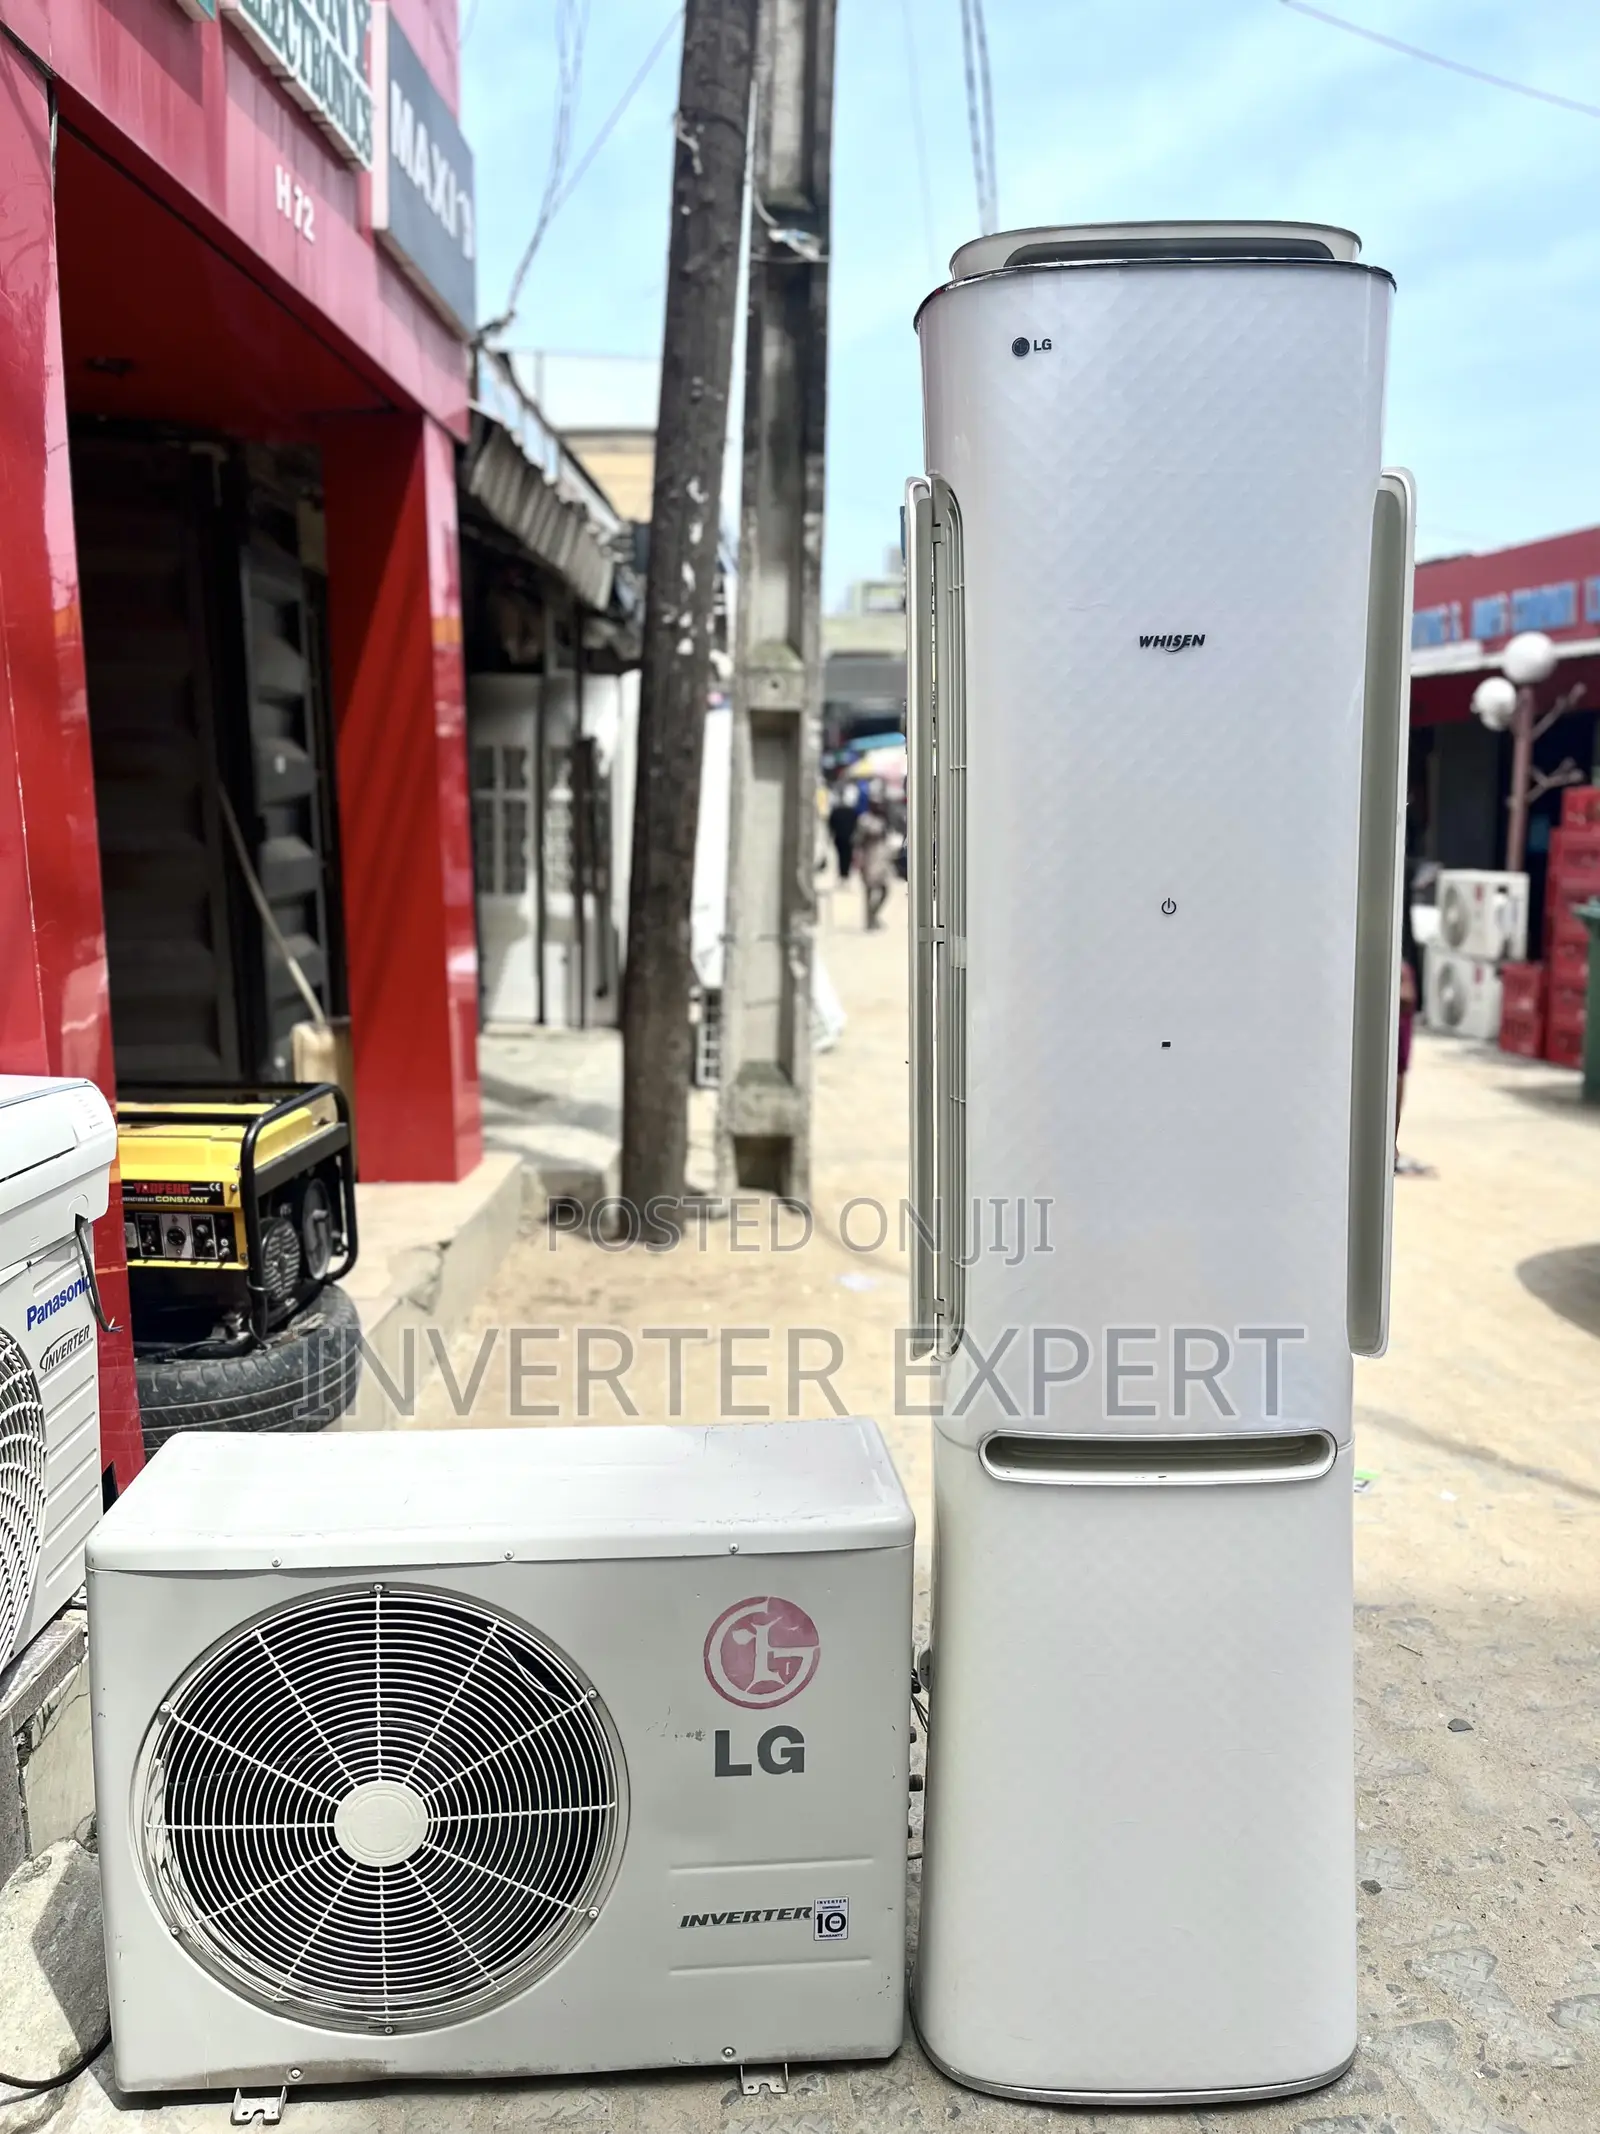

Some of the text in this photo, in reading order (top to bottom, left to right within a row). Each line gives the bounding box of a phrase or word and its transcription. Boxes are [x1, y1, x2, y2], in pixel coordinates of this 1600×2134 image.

[1033, 338, 1052, 351] LG
[1139, 634, 1206, 651] WHISEN
[155, 1196, 210, 1204] CONSTANT
[43, 1324, 90, 1373] INVERTER
[714, 1724, 805, 1777] LG
[680, 1906, 813, 1928] INVERTER
[816, 1912, 847, 1934] 10
